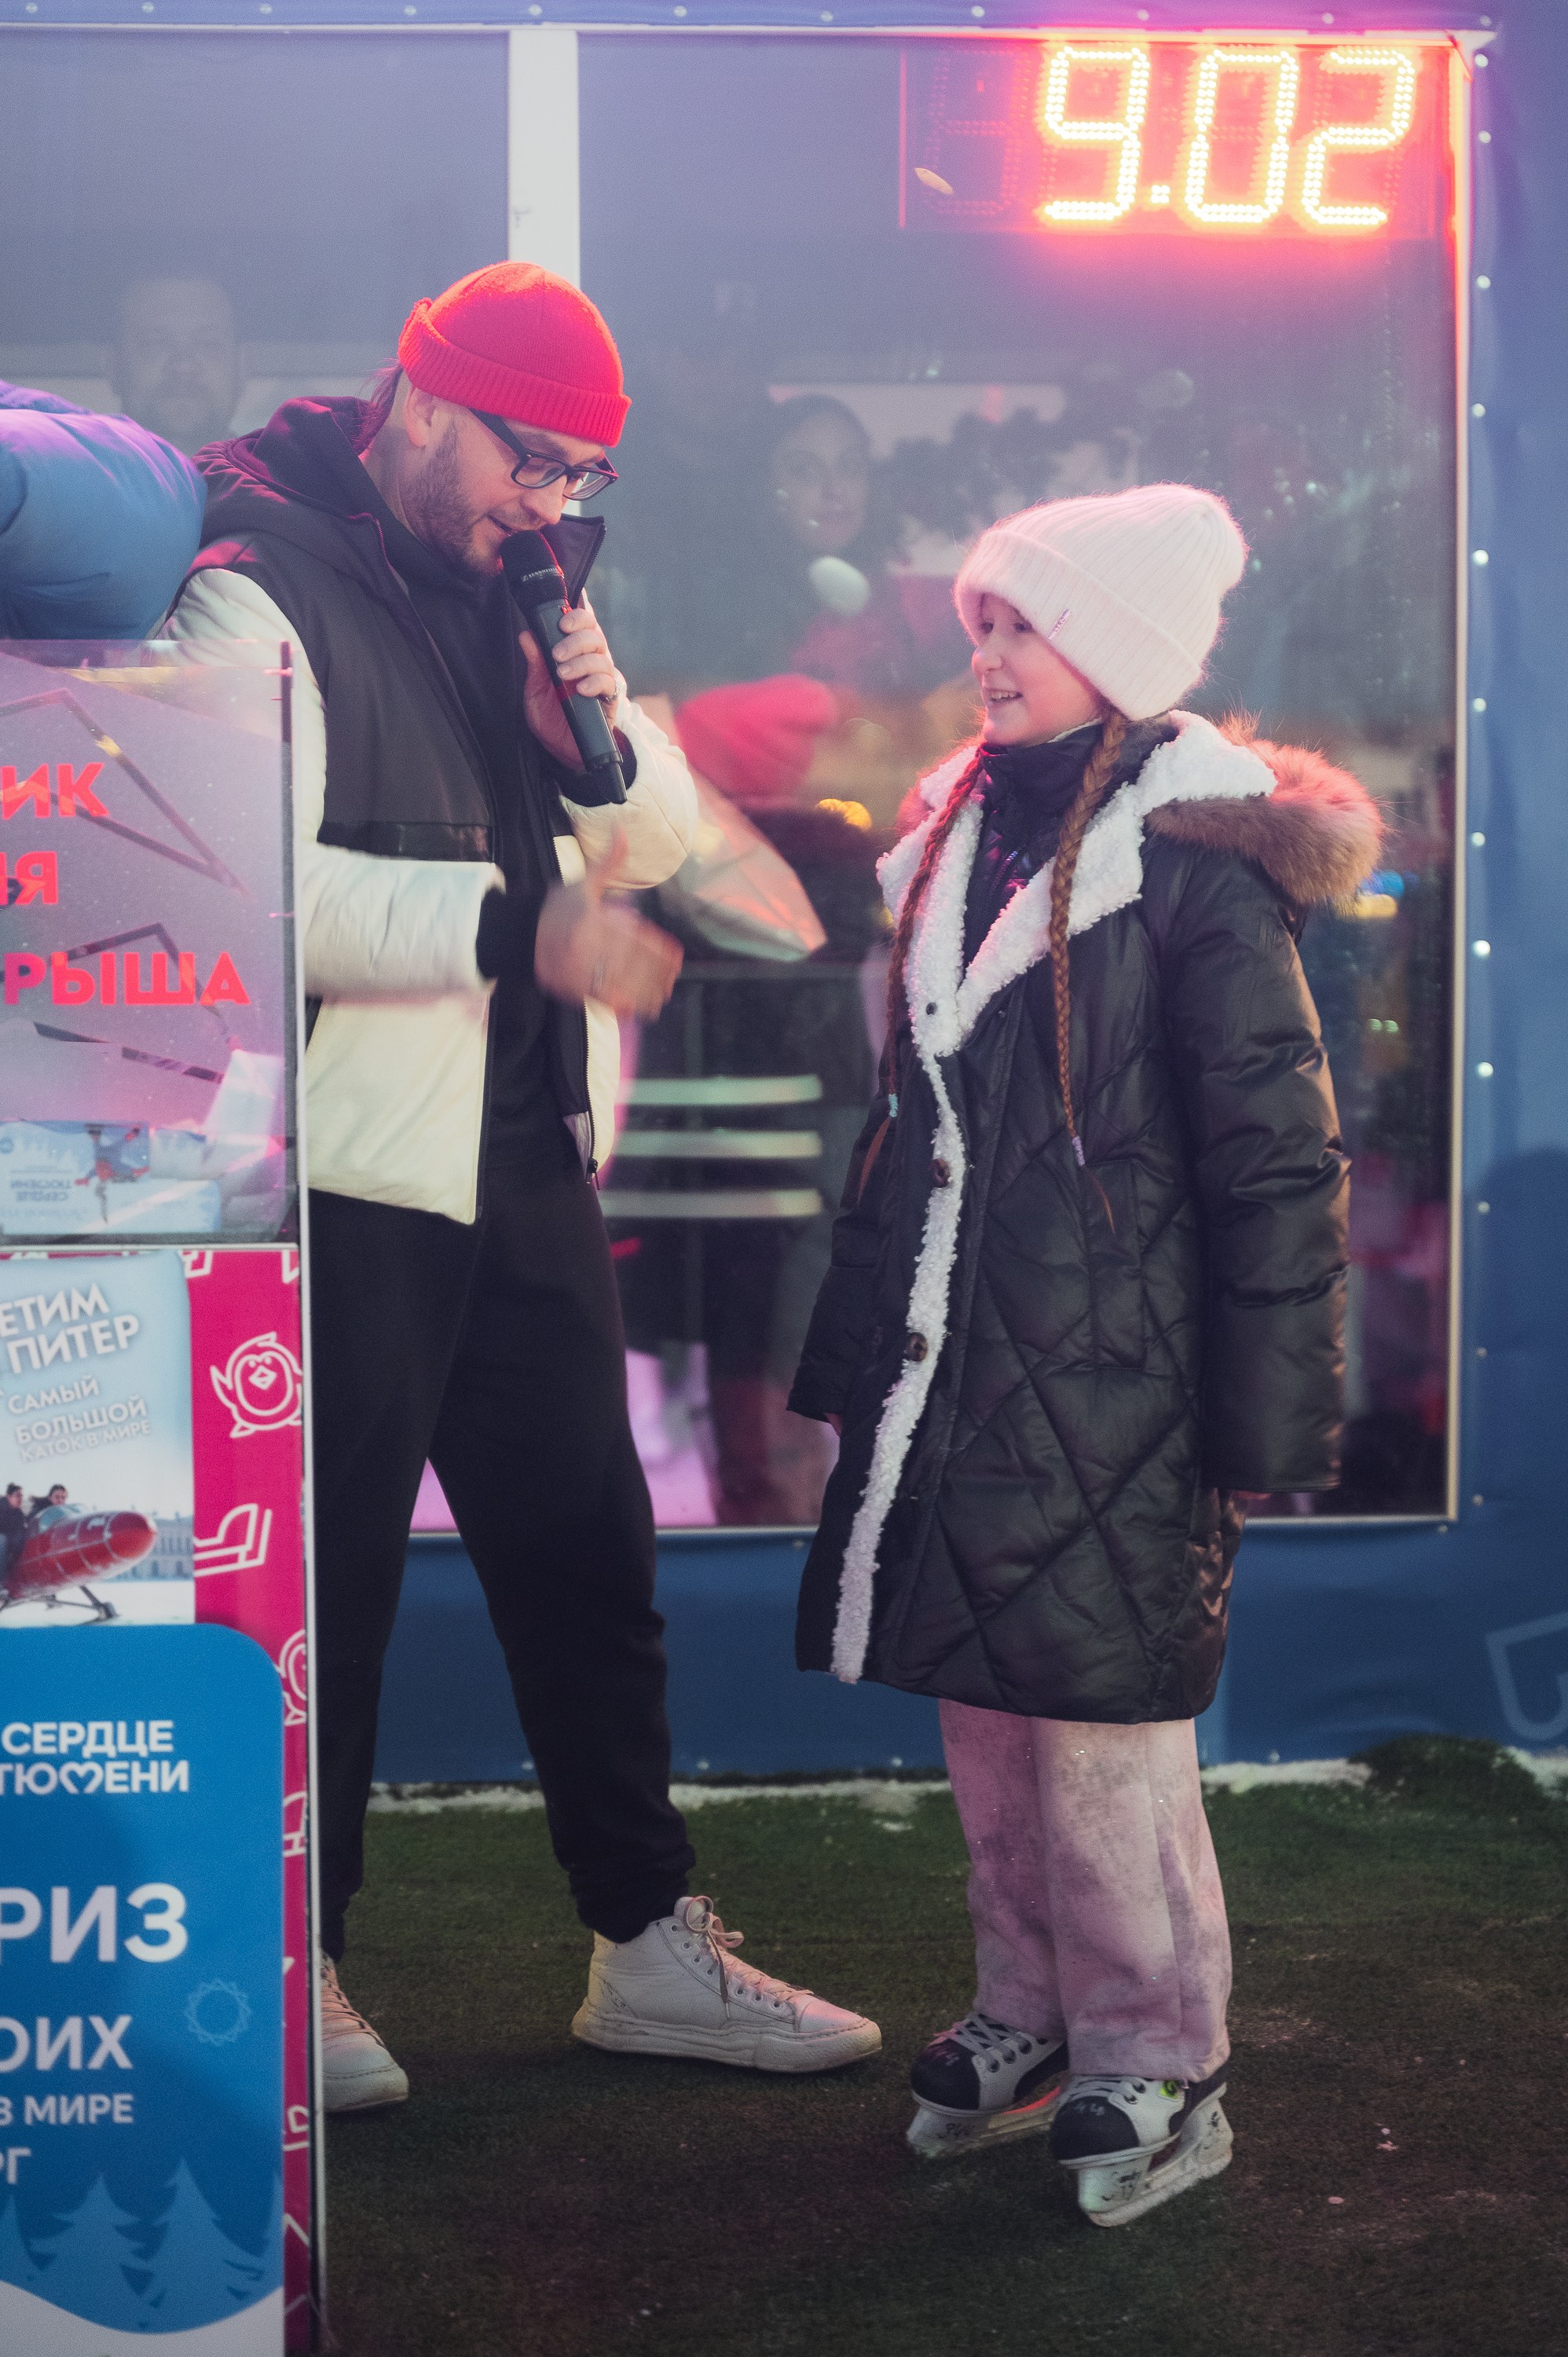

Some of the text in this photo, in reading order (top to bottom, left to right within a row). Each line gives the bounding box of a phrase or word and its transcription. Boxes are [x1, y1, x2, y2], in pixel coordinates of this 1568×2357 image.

[1044, 45, 1416, 226] 9.02
[2, 762, 109, 819] ИК
[0, 852, 58, 905] Я
[4, 951, 251, 1006] РЫША
[0, 1282, 110, 1336] ЕТИМ
[6, 1314, 140, 1374] ПИТЕР
[8, 1374, 100, 1414] САМЫЙ
[16, 1394, 148, 1444] БОЛЬШОЙ
[21, 1419, 152, 1462] КАТОК В МИРЕ
[2, 1720, 174, 1759] СЕРДЦЕ
[0, 1882, 189, 1963] РИЗ
[24, 2093, 134, 2125] МИРЕ
[0, 2146, 31, 2185] Г
